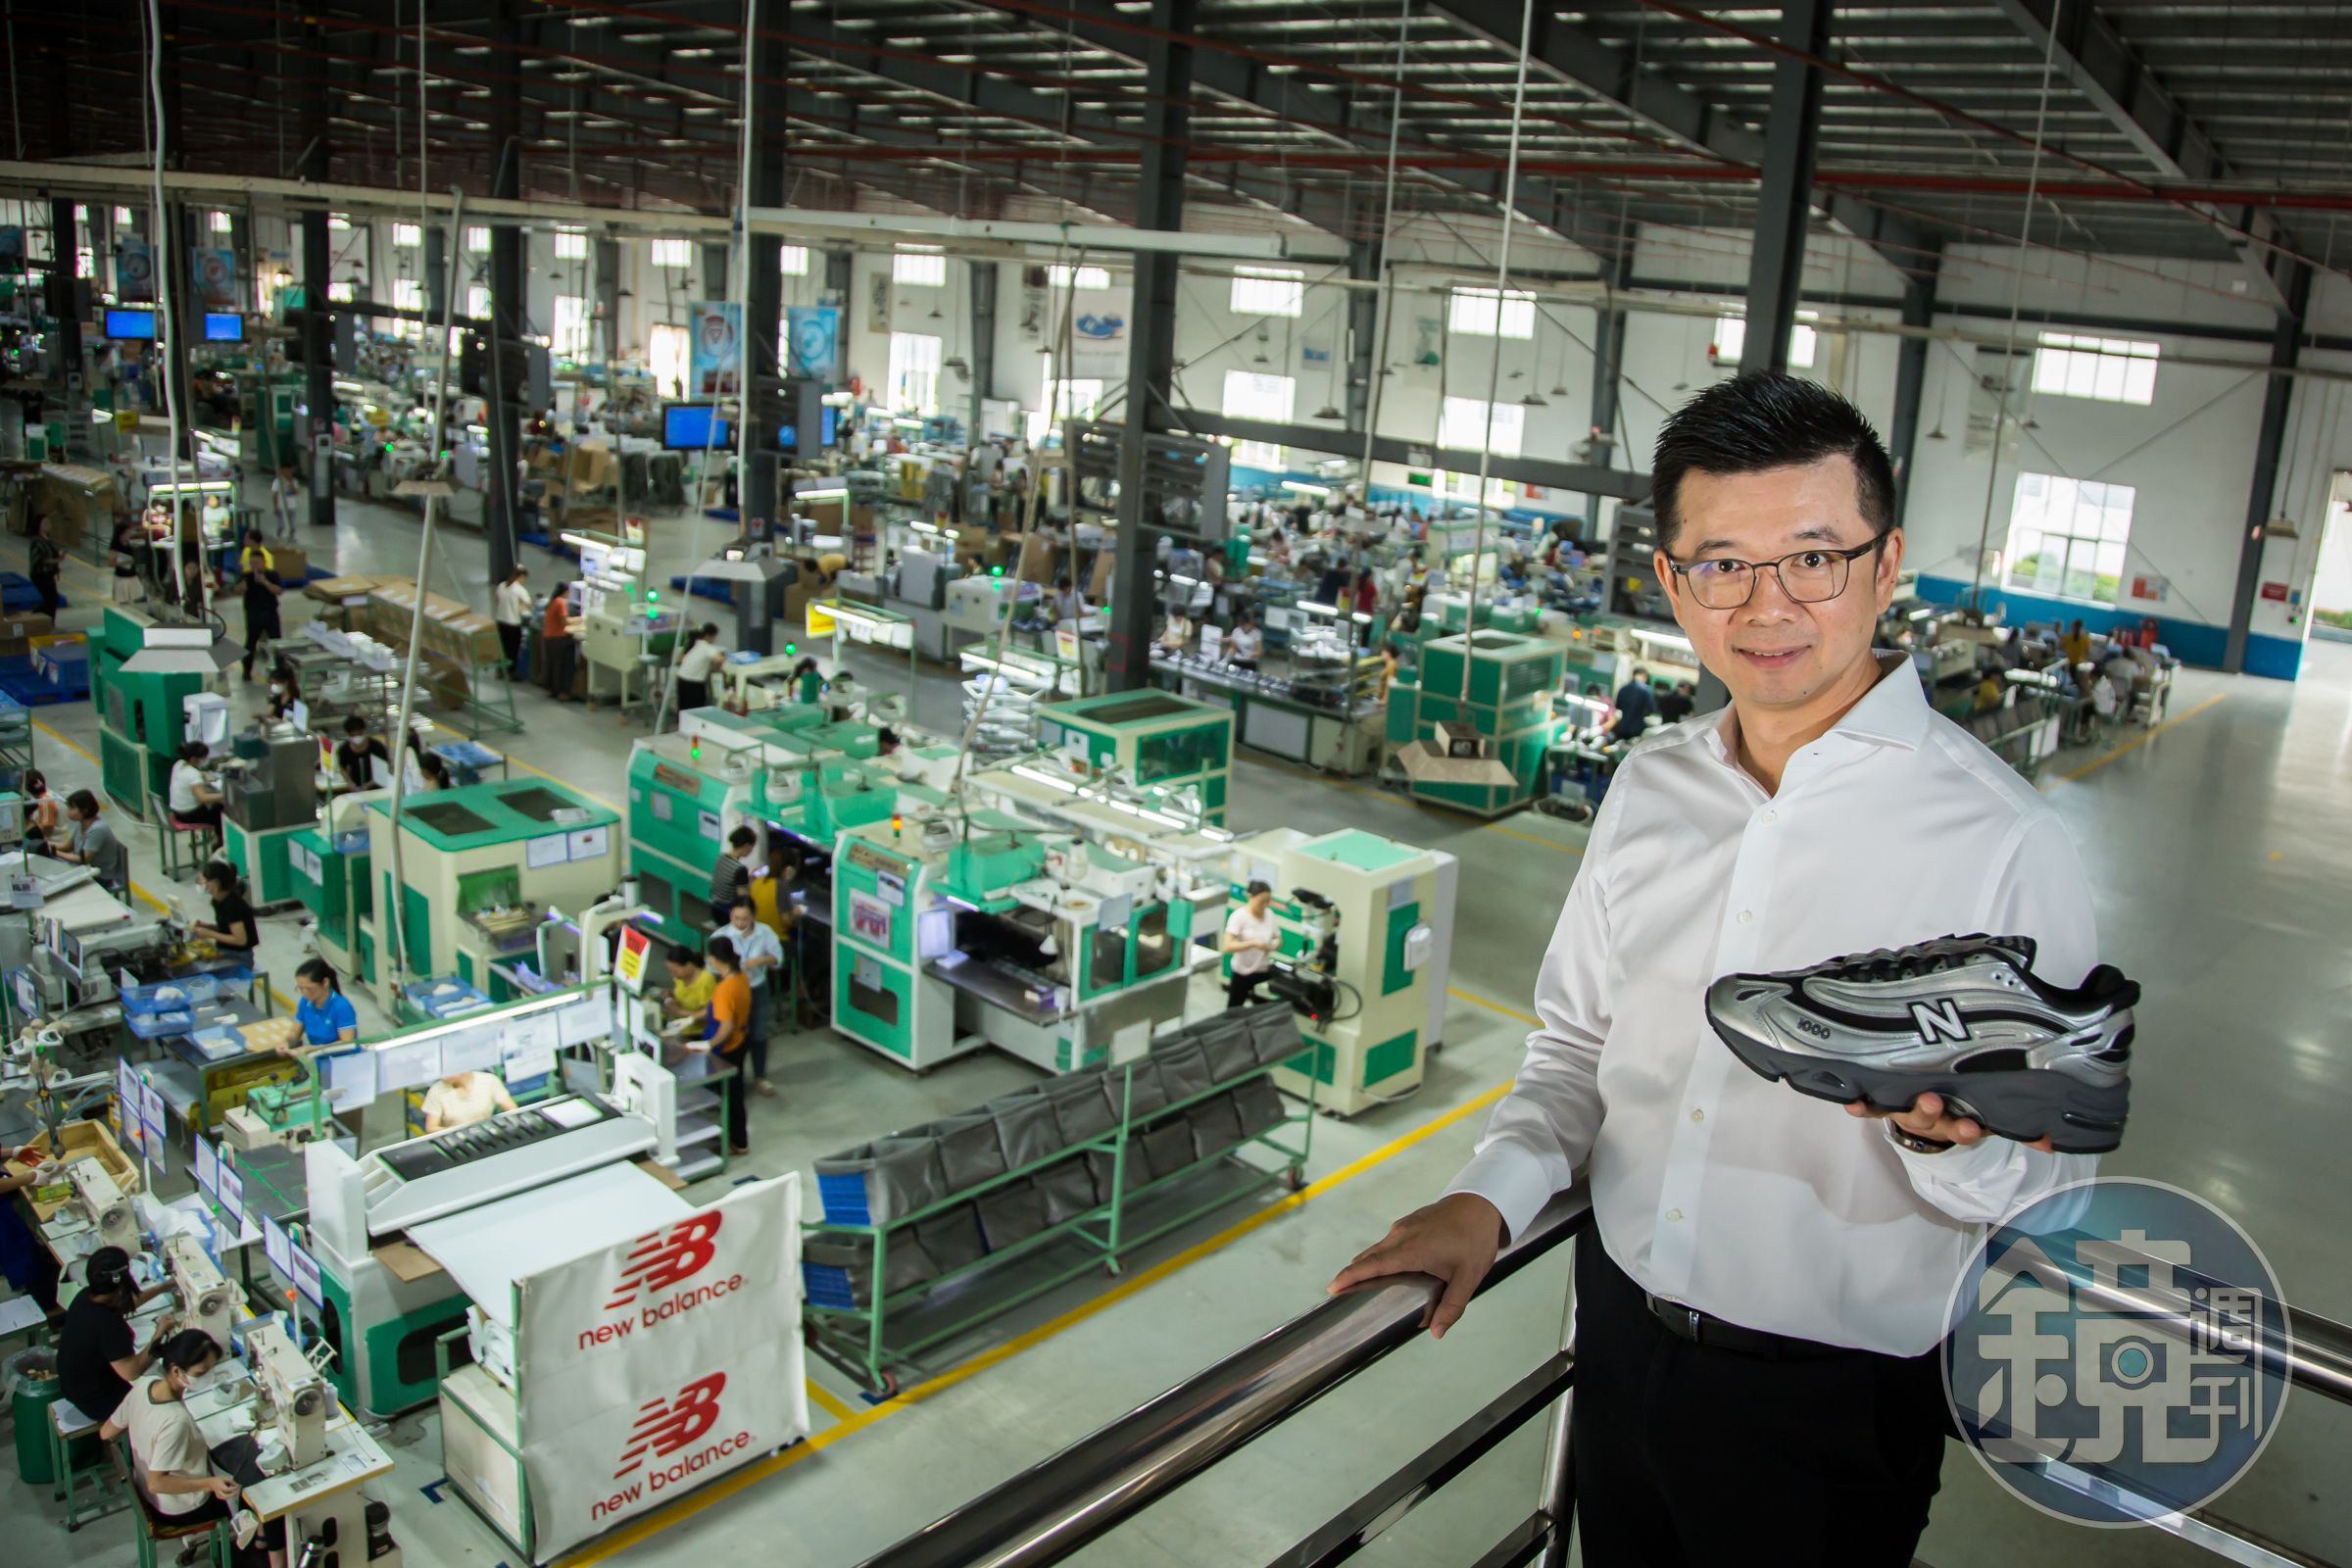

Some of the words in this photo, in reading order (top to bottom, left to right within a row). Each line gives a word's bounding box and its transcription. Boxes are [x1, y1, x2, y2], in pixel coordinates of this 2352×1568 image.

[1796, 1016, 1831, 1040] 1000
[1907, 998, 1972, 1045] N
[578, 1316, 635, 1350] new
[642, 1274, 743, 1329] balance
[591, 1482, 643, 1521] new
[649, 1431, 750, 1493] balance
